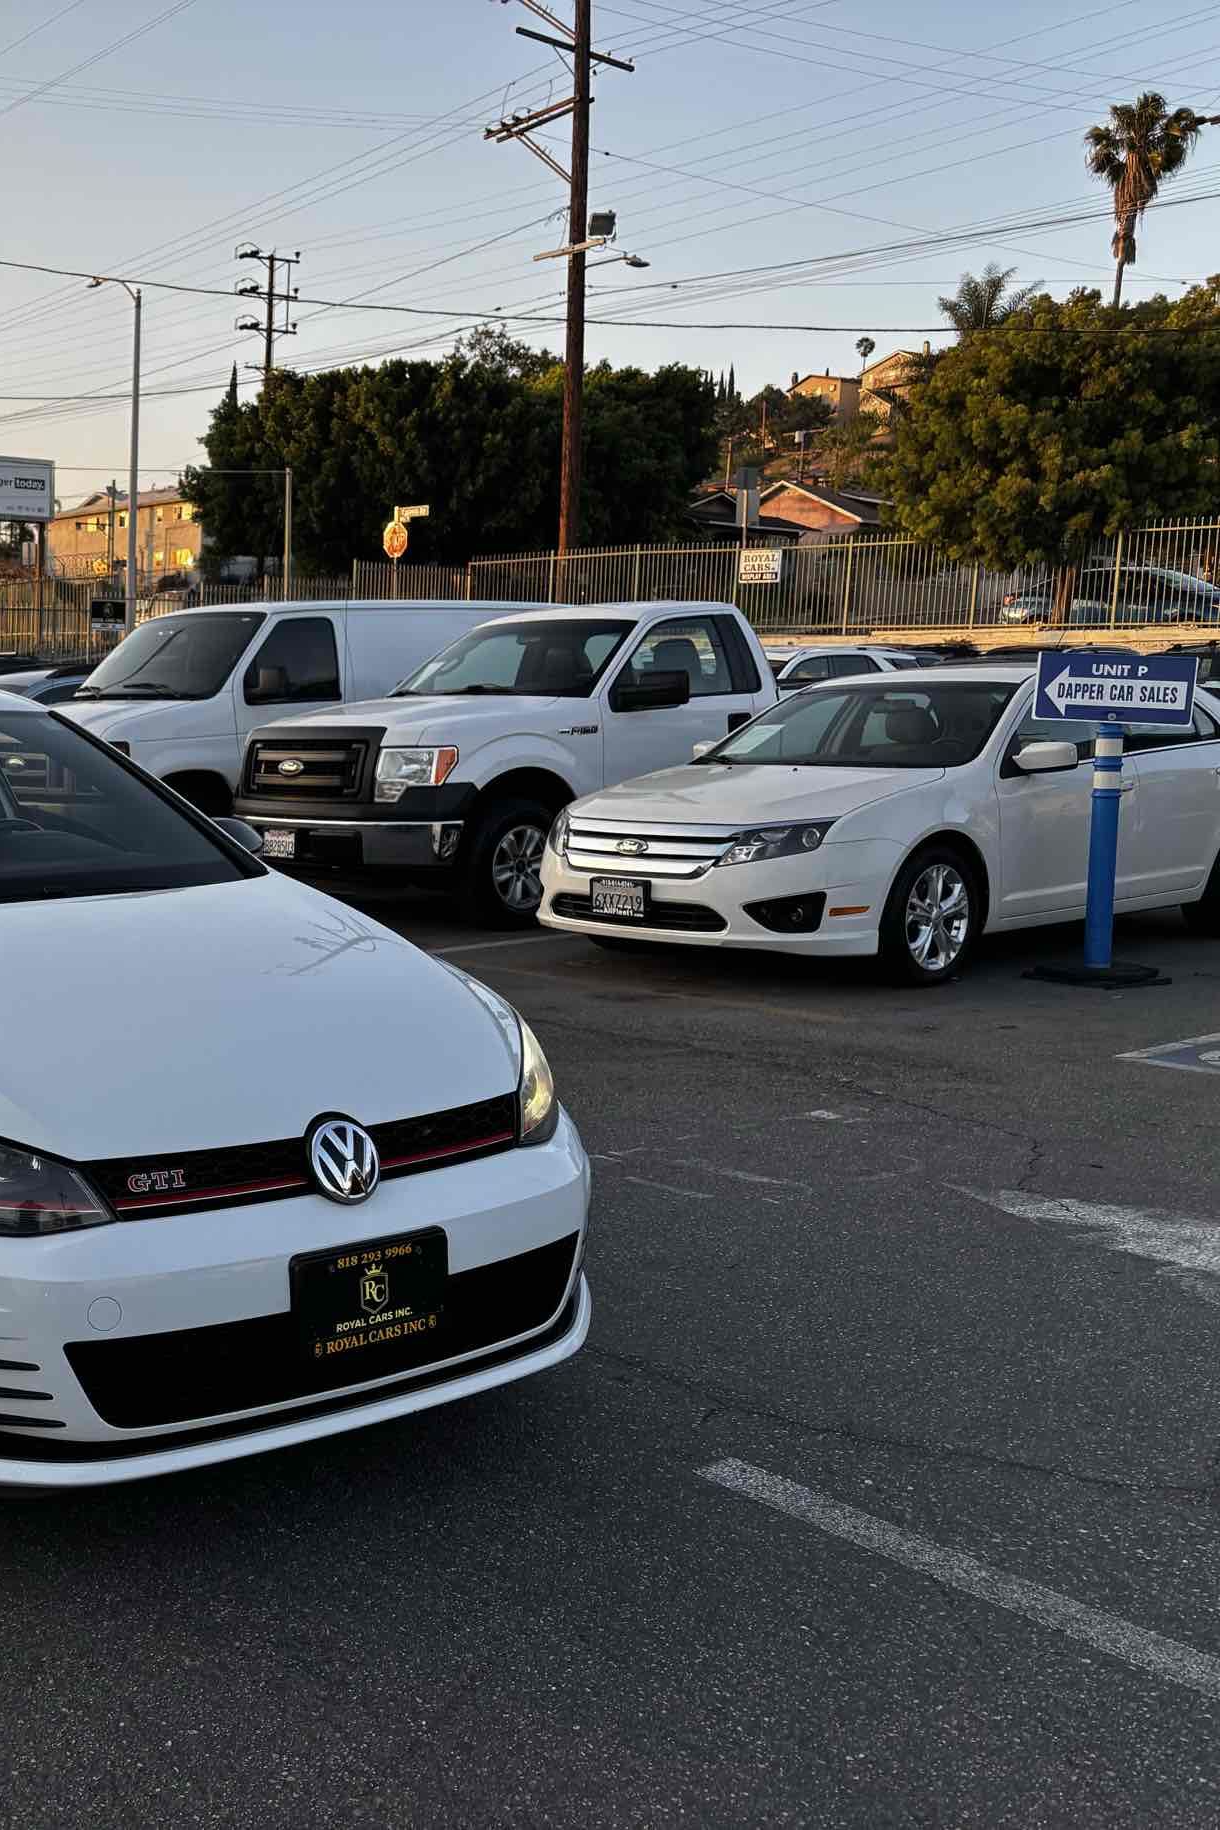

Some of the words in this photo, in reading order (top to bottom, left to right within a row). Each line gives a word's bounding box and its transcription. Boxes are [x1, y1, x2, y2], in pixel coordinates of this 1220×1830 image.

[15, 478, 45, 491] today.
[743, 553, 778, 563] ROYAL
[1091, 663, 1131, 677] UNIT
[1137, 665, 1149, 677] P
[1057, 682, 1104, 701] DAPPER
[1109, 684, 1134, 702] CAR
[1139, 685, 1178, 704] SALES
[128, 1169, 186, 1192] GTI
[337, 1255, 358, 1269] 818
[361, 1250, 382, 1264] 293
[385, 1243, 412, 1259] 9966
[336, 1318, 367, 1333] ROYAL
[369, 1311, 393, 1325] CARS
[395, 1306, 413, 1318] INC.
[326, 1333, 367, 1355] ROYAL
[368, 1325, 401, 1343] CARS
[403, 1318, 426, 1335] INC
